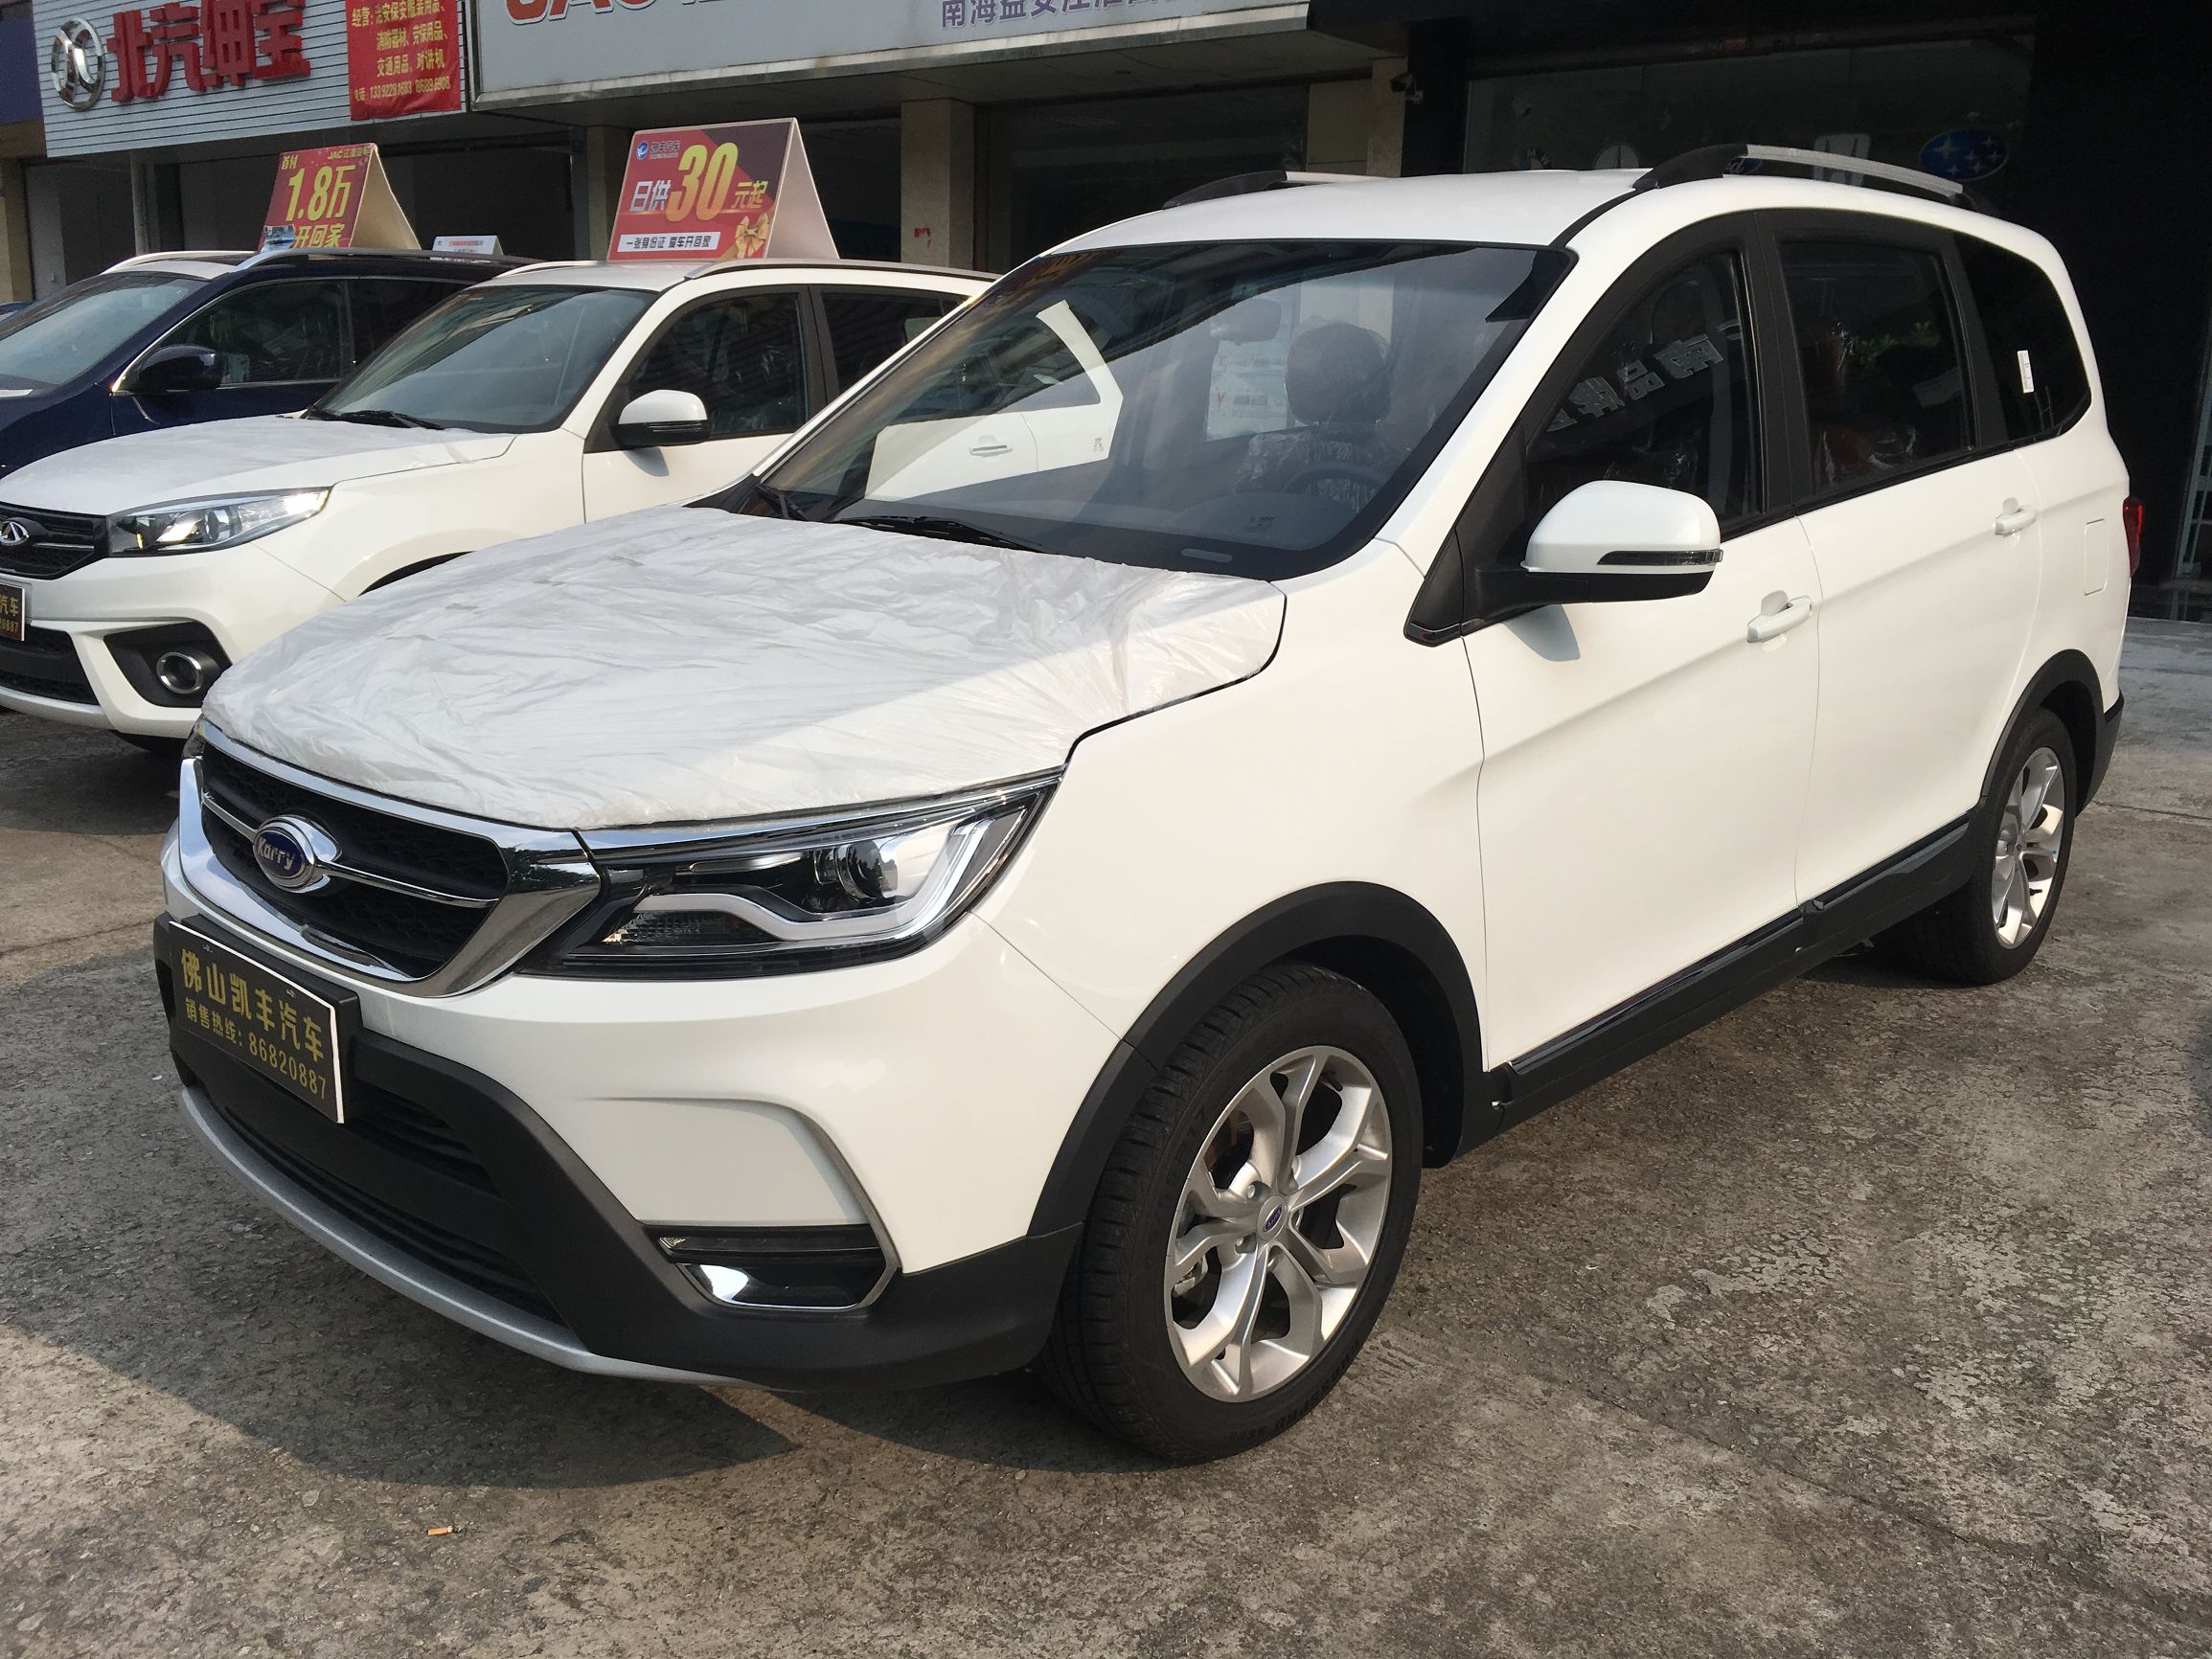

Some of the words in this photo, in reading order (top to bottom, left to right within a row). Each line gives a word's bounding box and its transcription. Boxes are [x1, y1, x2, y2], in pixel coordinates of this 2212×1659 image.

[281, 155, 298, 170] 首付
[285, 165, 355, 221] 1.8万
[627, 237, 666, 249] 一张身份证
[181, 948, 324, 1062] 佛山凯丰汽车
[248, 1032, 327, 1100] 86820887
